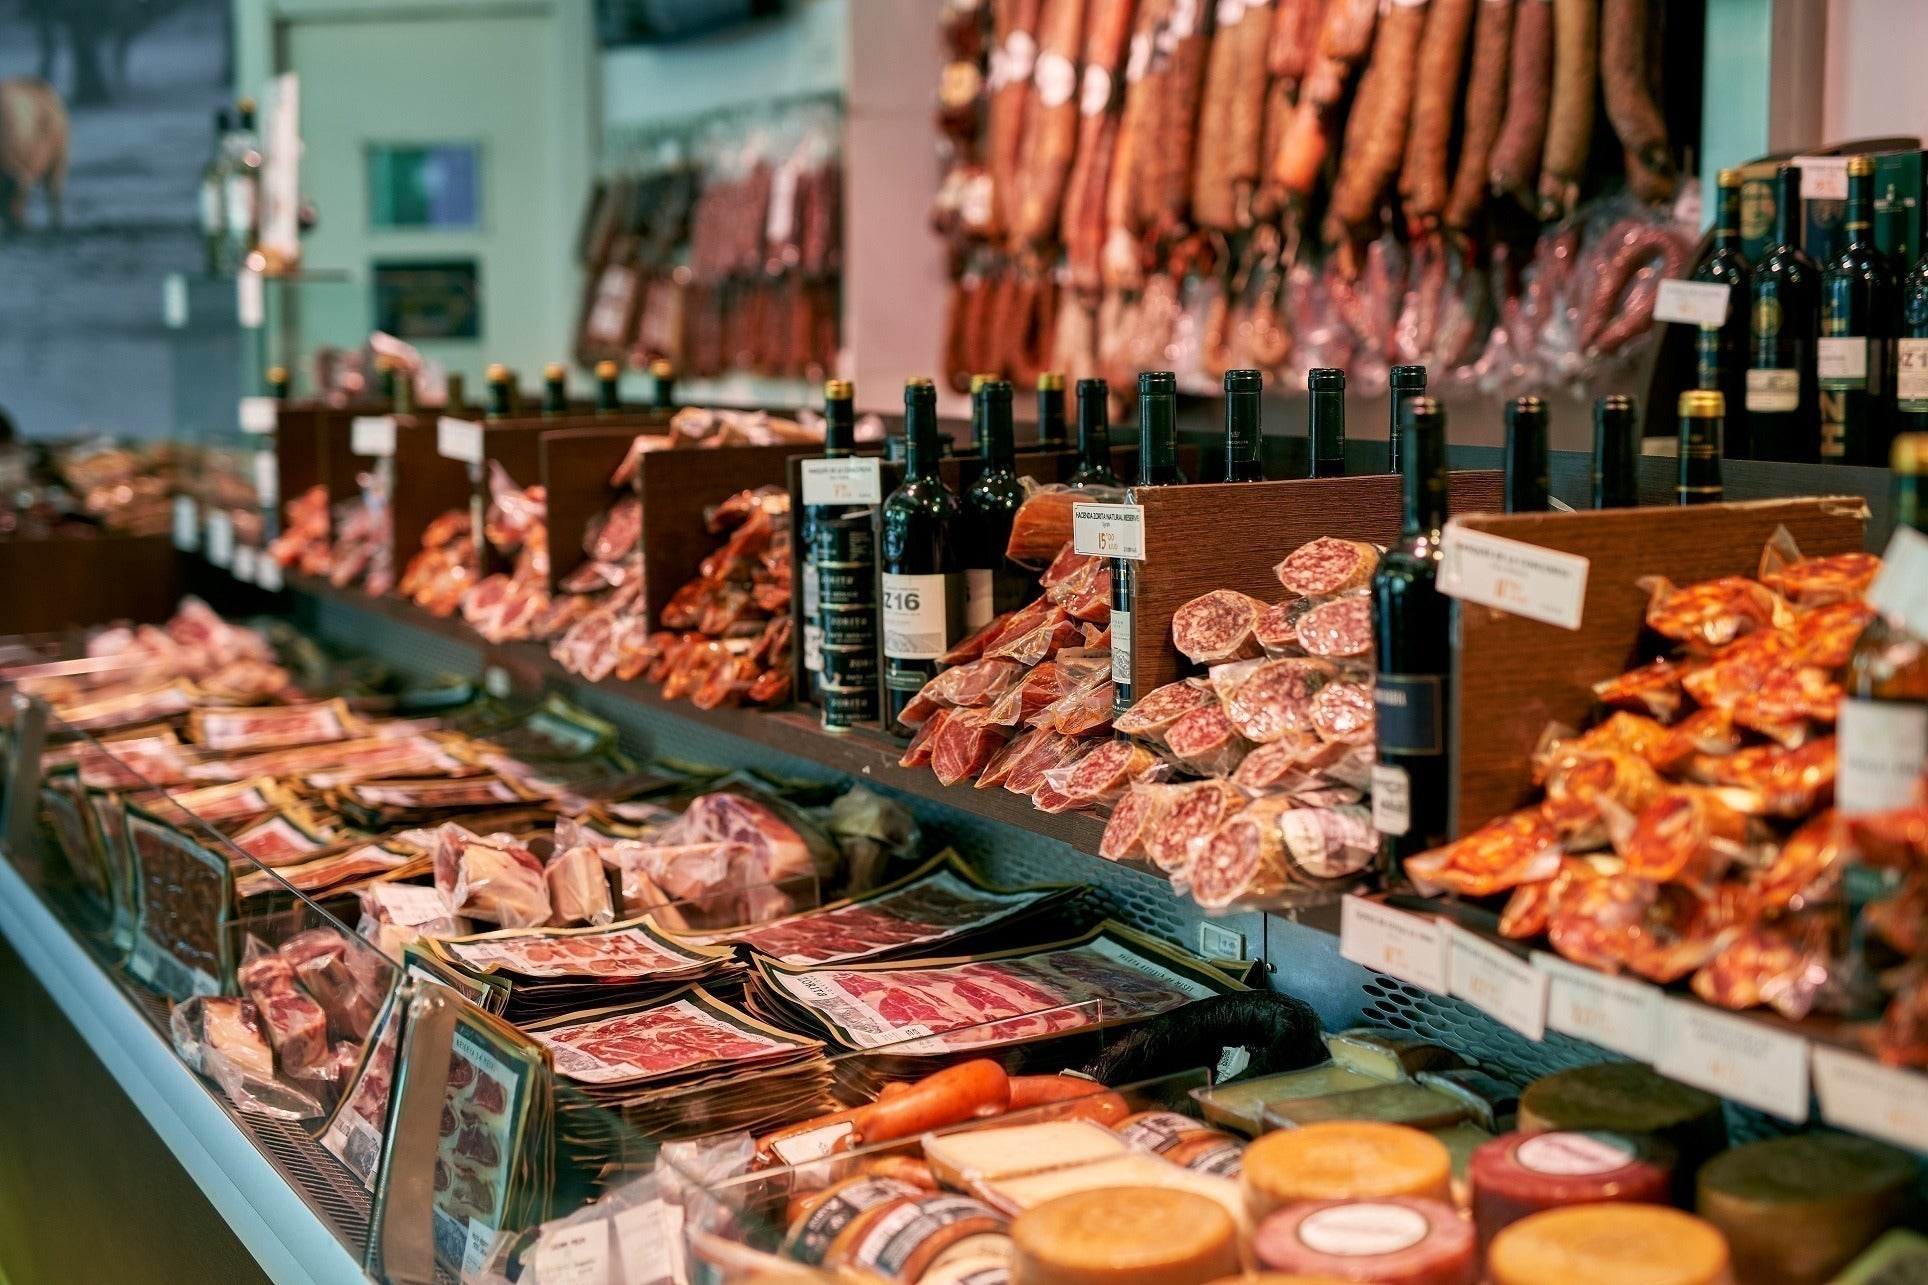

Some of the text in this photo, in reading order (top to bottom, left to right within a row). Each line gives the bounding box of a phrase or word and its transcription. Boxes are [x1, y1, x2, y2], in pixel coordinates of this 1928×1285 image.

[1106, 513, 1123, 521] NATURAL
[884, 592, 920, 611] Z16
[797, 976, 828, 998] ZORITA
